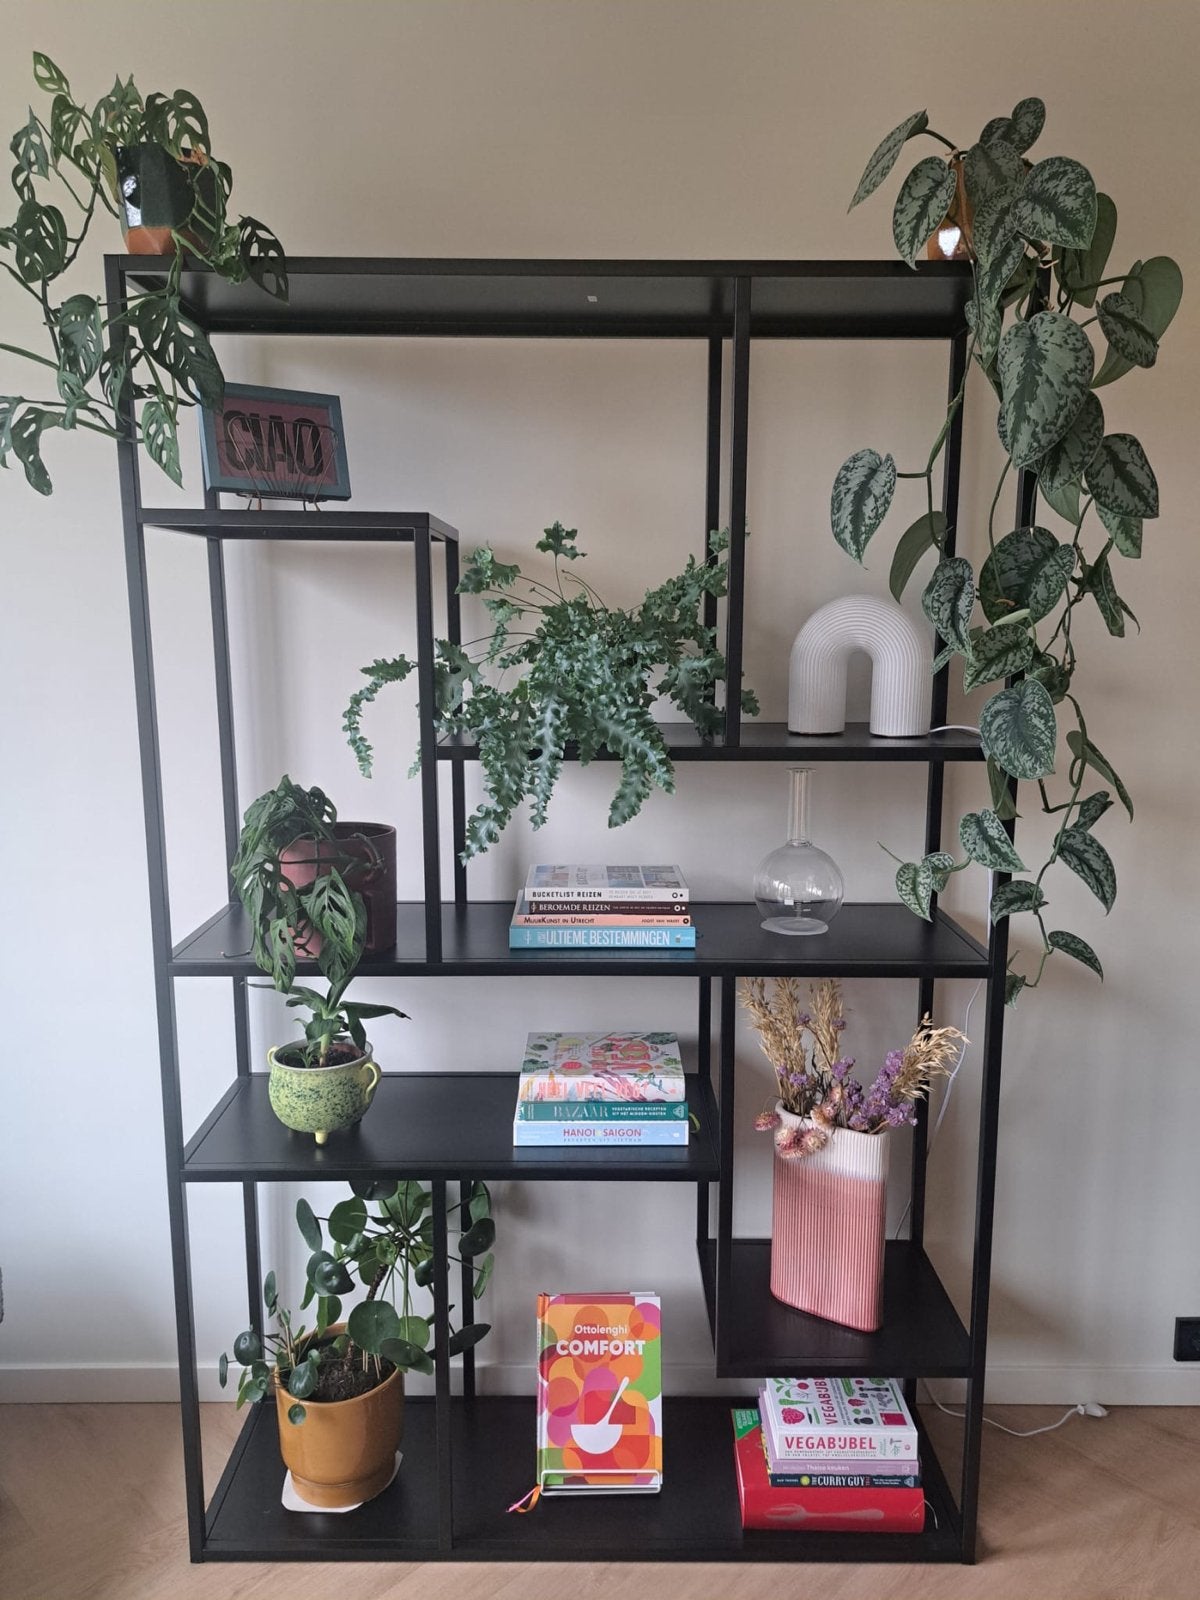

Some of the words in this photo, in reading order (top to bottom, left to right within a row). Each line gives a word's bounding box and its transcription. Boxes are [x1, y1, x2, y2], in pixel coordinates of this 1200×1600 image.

[223, 410, 324, 477] CIAO
[539, 903, 581, 911] BEROEMDE
[546, 930, 588, 945] ULTIEME
[589, 930, 670, 945] BESTEMMINGEN
[553, 1106, 608, 1118] BAZAAR
[563, 1128, 595, 1137] HANOI
[602, 1128, 642, 1137] SAIGON
[574, 1324, 628, 1336] Ottolenghi
[556, 1340, 646, 1356] COMFORT
[817, 1475, 847, 1486] CURRY
[847, 1475, 865, 1486] GUY
